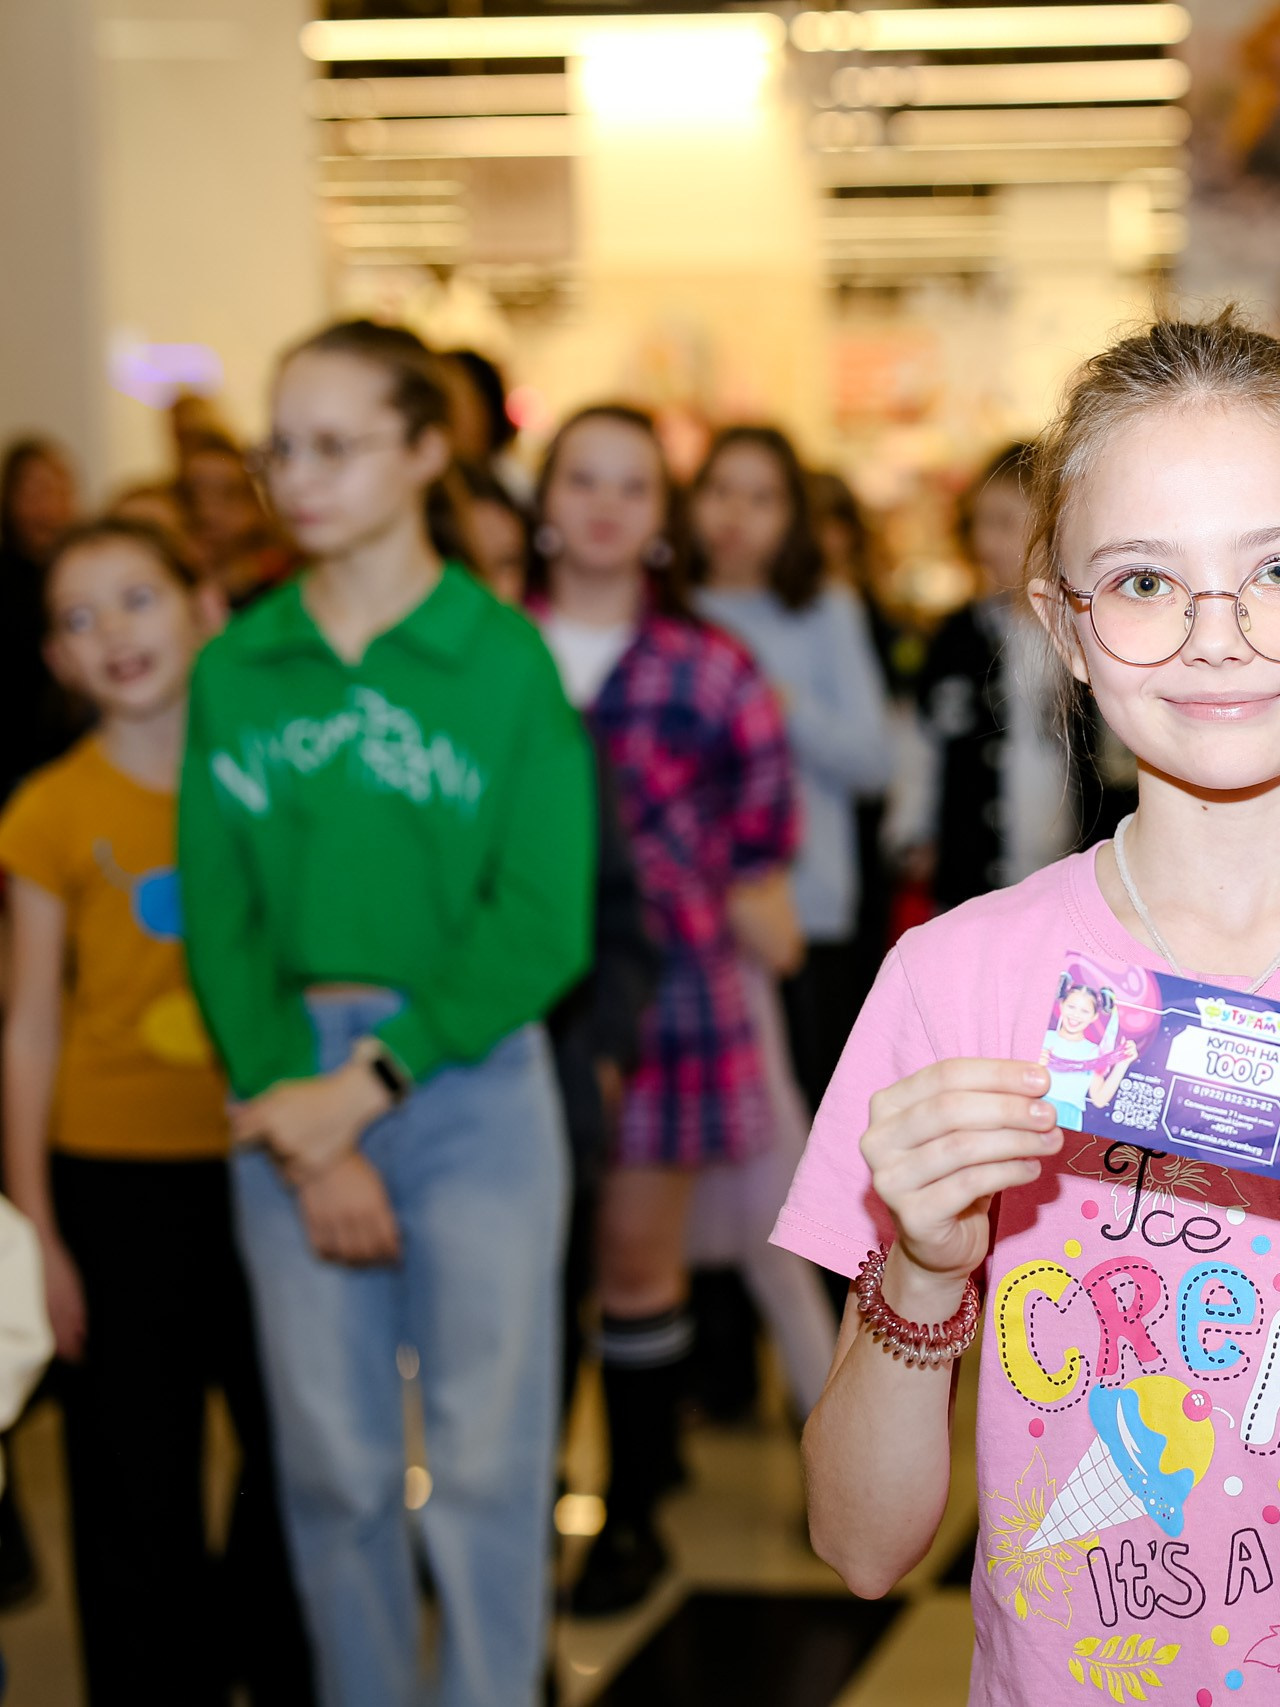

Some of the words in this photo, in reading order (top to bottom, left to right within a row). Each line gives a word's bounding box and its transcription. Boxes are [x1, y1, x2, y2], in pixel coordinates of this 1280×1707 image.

[1207, 1036, 1257, 1058] КУПОН
[1259, 1049, 1279, 1063] НА
[1100, 1140, 1231, 1253] Ice
[1224, 1527, 1274, 1605] A
